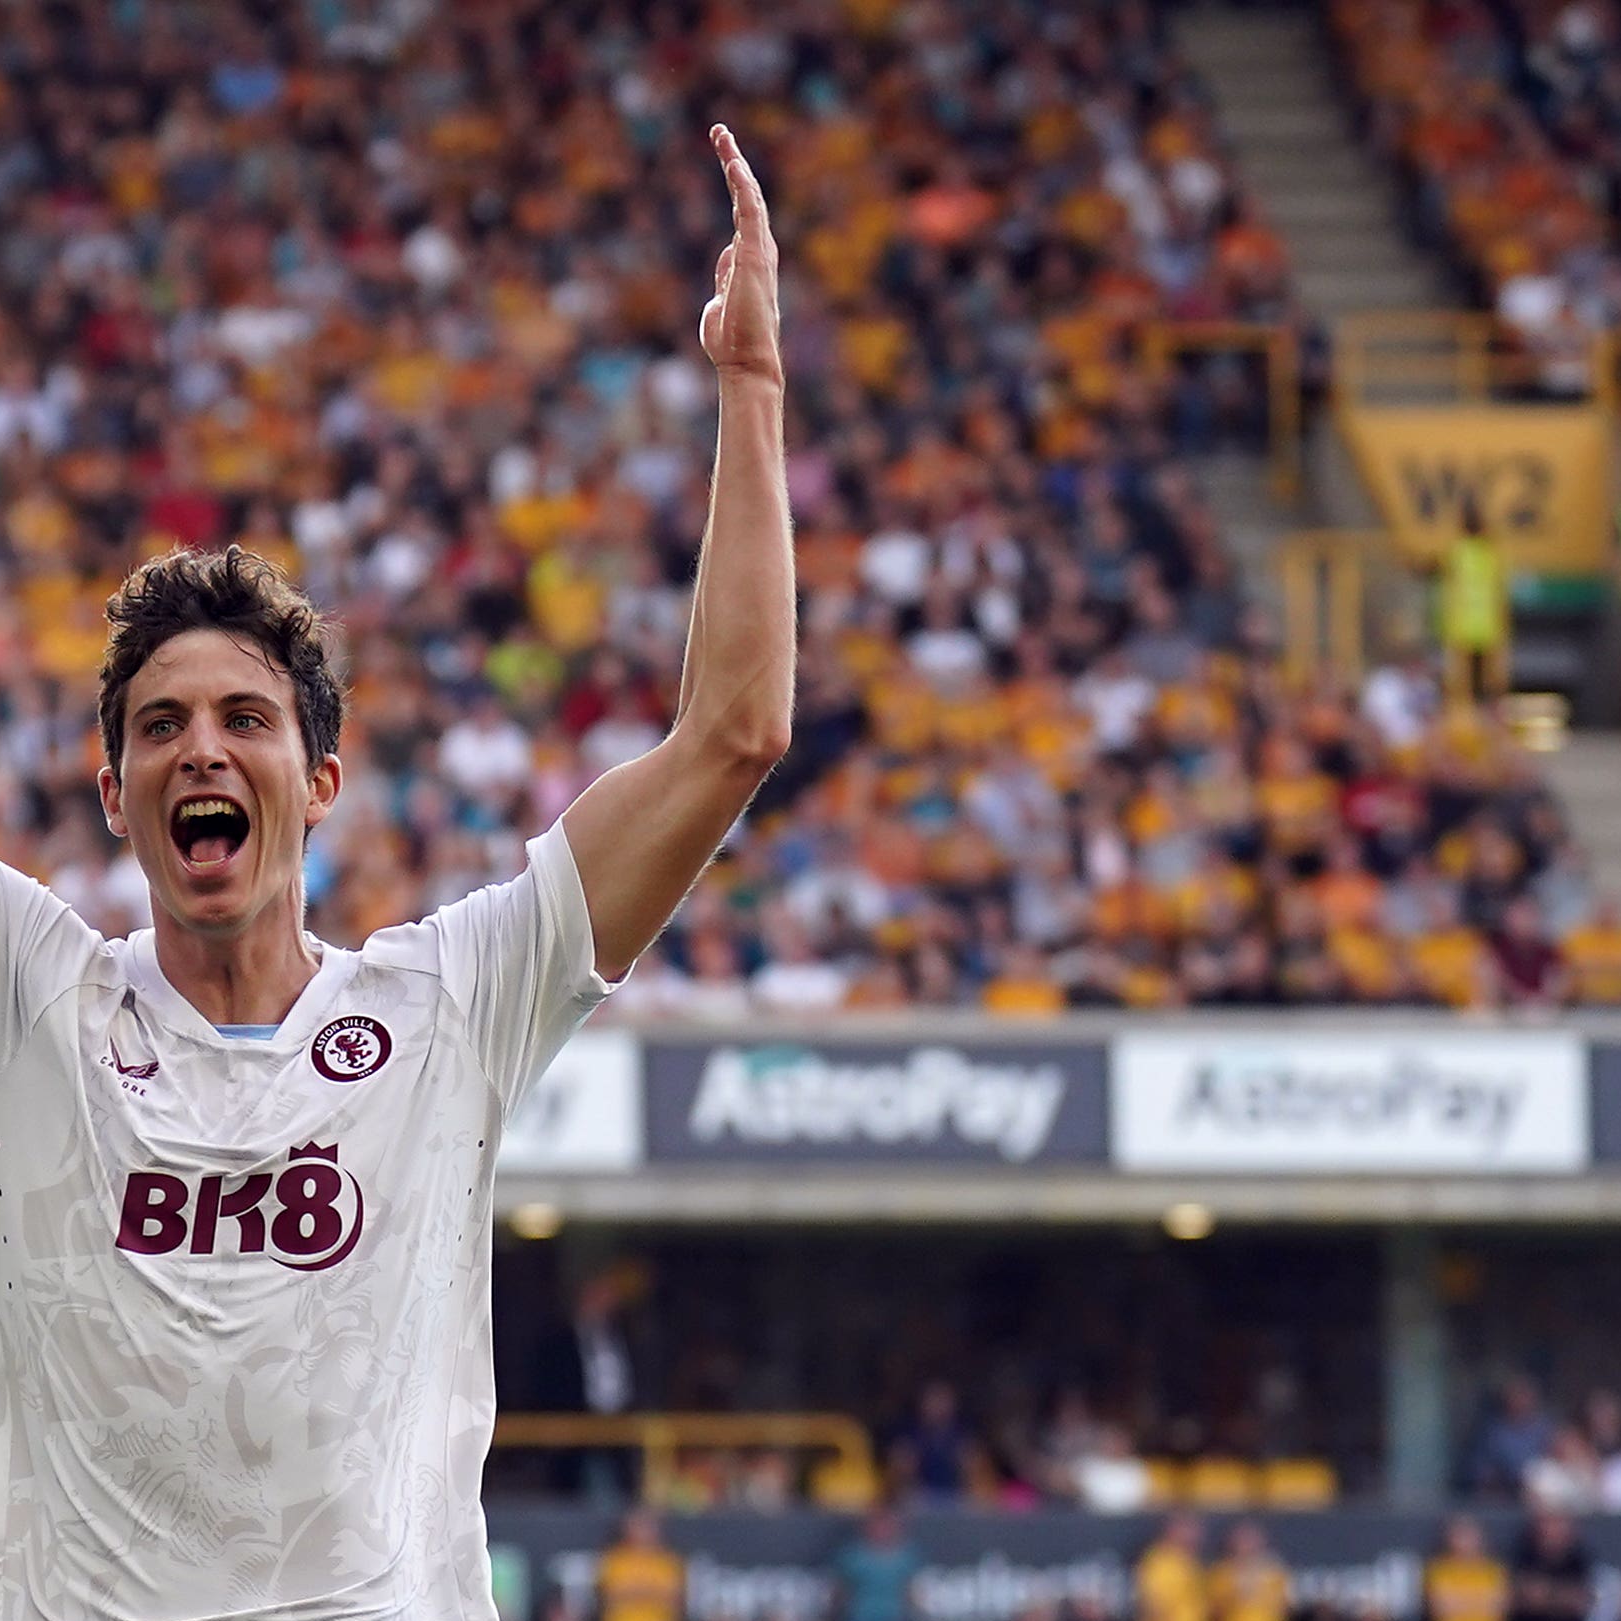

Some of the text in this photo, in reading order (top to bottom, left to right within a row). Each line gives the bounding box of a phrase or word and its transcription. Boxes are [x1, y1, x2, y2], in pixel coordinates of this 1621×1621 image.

[1399, 452, 1557, 530] W2
[99, 1056, 147, 1097] CAORE
[315, 1019, 374, 1053] ASTON VILLA
[687, 1046, 1067, 1158] AstroPay
[1177, 1054, 1527, 1144] AstroPay
[115, 1163, 344, 1256] BK8
